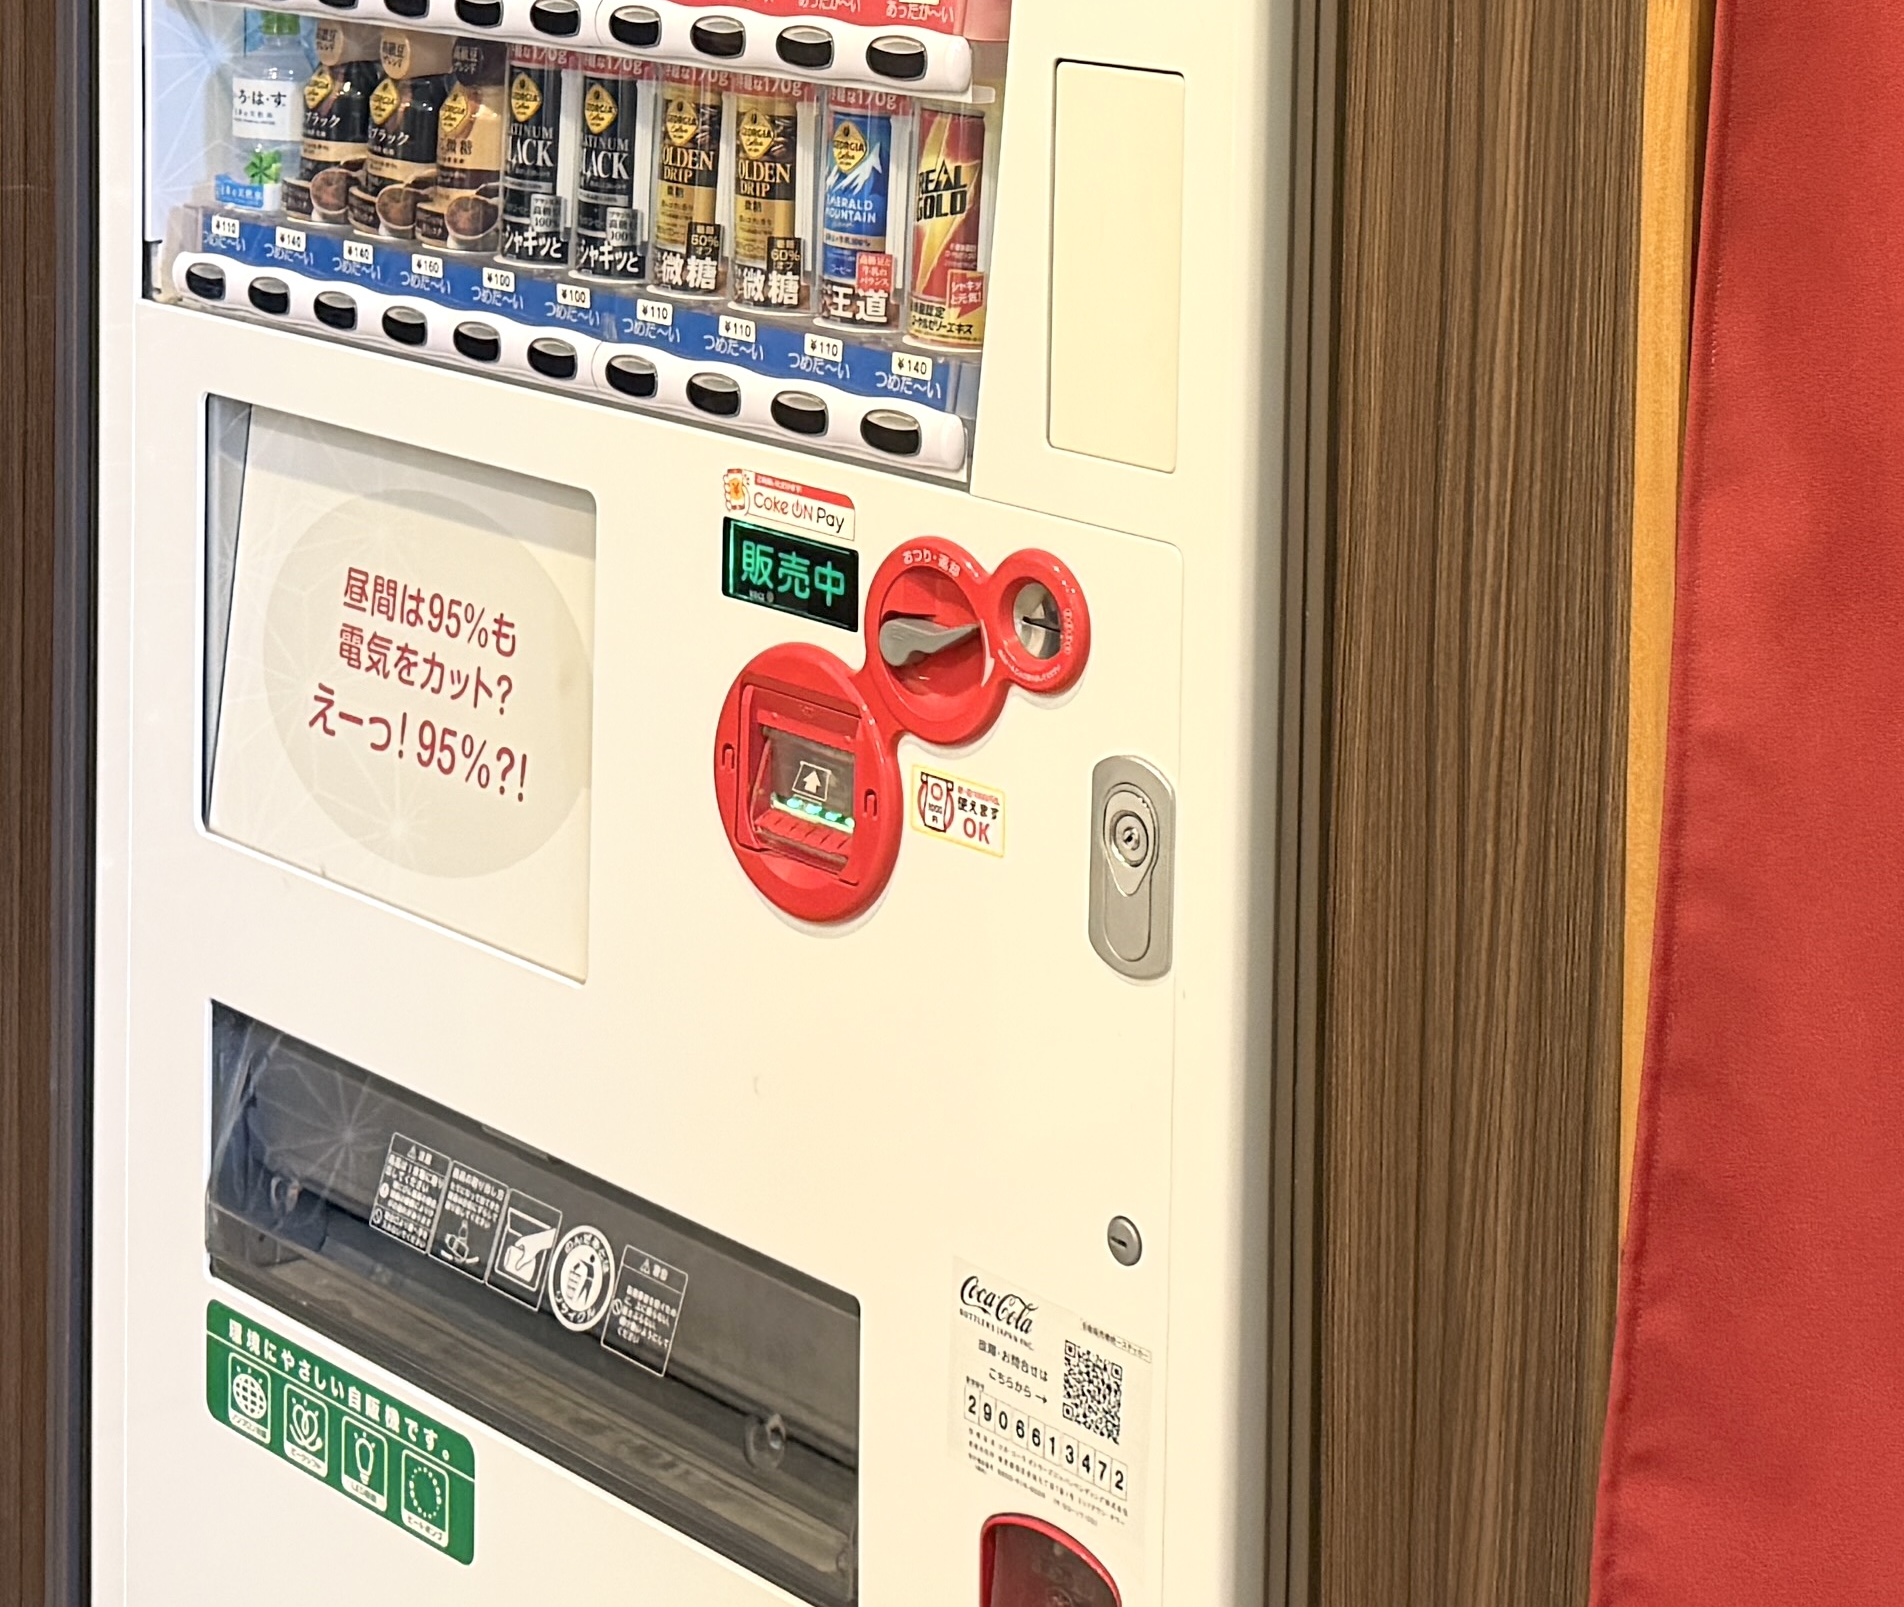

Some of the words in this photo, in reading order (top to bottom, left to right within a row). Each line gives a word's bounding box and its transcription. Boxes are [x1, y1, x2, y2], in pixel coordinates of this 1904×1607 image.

[507, 137, 554, 171] LACK
[581, 148, 630, 183] LACK
[661, 146, 715, 171] OLDEN
[663, 166, 693, 184] DRIP
[738, 160, 792, 184] OLDEN
[918, 158, 968, 196] REAL
[740, 180, 771, 198] DRIP
[916, 190, 967, 222] GOLD
[504, 225, 562, 260] シャキッと
[580, 238, 640, 274] シャキッと
[690, 233, 720, 247] 60%
[770, 248, 800, 262] 60%
[487, 273, 511, 288] ¥100
[661, 252, 718, 290] 微糖
[742, 266, 800, 305] 微糖
[859, 275, 890, 287] バランス
[561, 289, 586, 304] ¥100
[642, 305, 668, 320] ¥110
[830, 284, 889, 324] 王道
[724, 321, 751, 338] ¥110
[810, 339, 838, 357] ¥110
[897, 357, 927, 375] ¥140
[753, 491, 789, 516] Coke
[792, 499, 813, 522] ON
[816, 506, 845, 534] Pay
[741, 539, 846, 608] 販売中
[343, 566, 517, 658] 昼間は95%も
[339, 622, 513, 716] 電気をカット?
[963, 817, 990, 845] OK
[960, 1275, 1039, 1335] Coca-Cola
[228, 1318, 450, 1461] 環境にやさしい自販機です。
[988, 1367, 1032, 1399] こちらから
